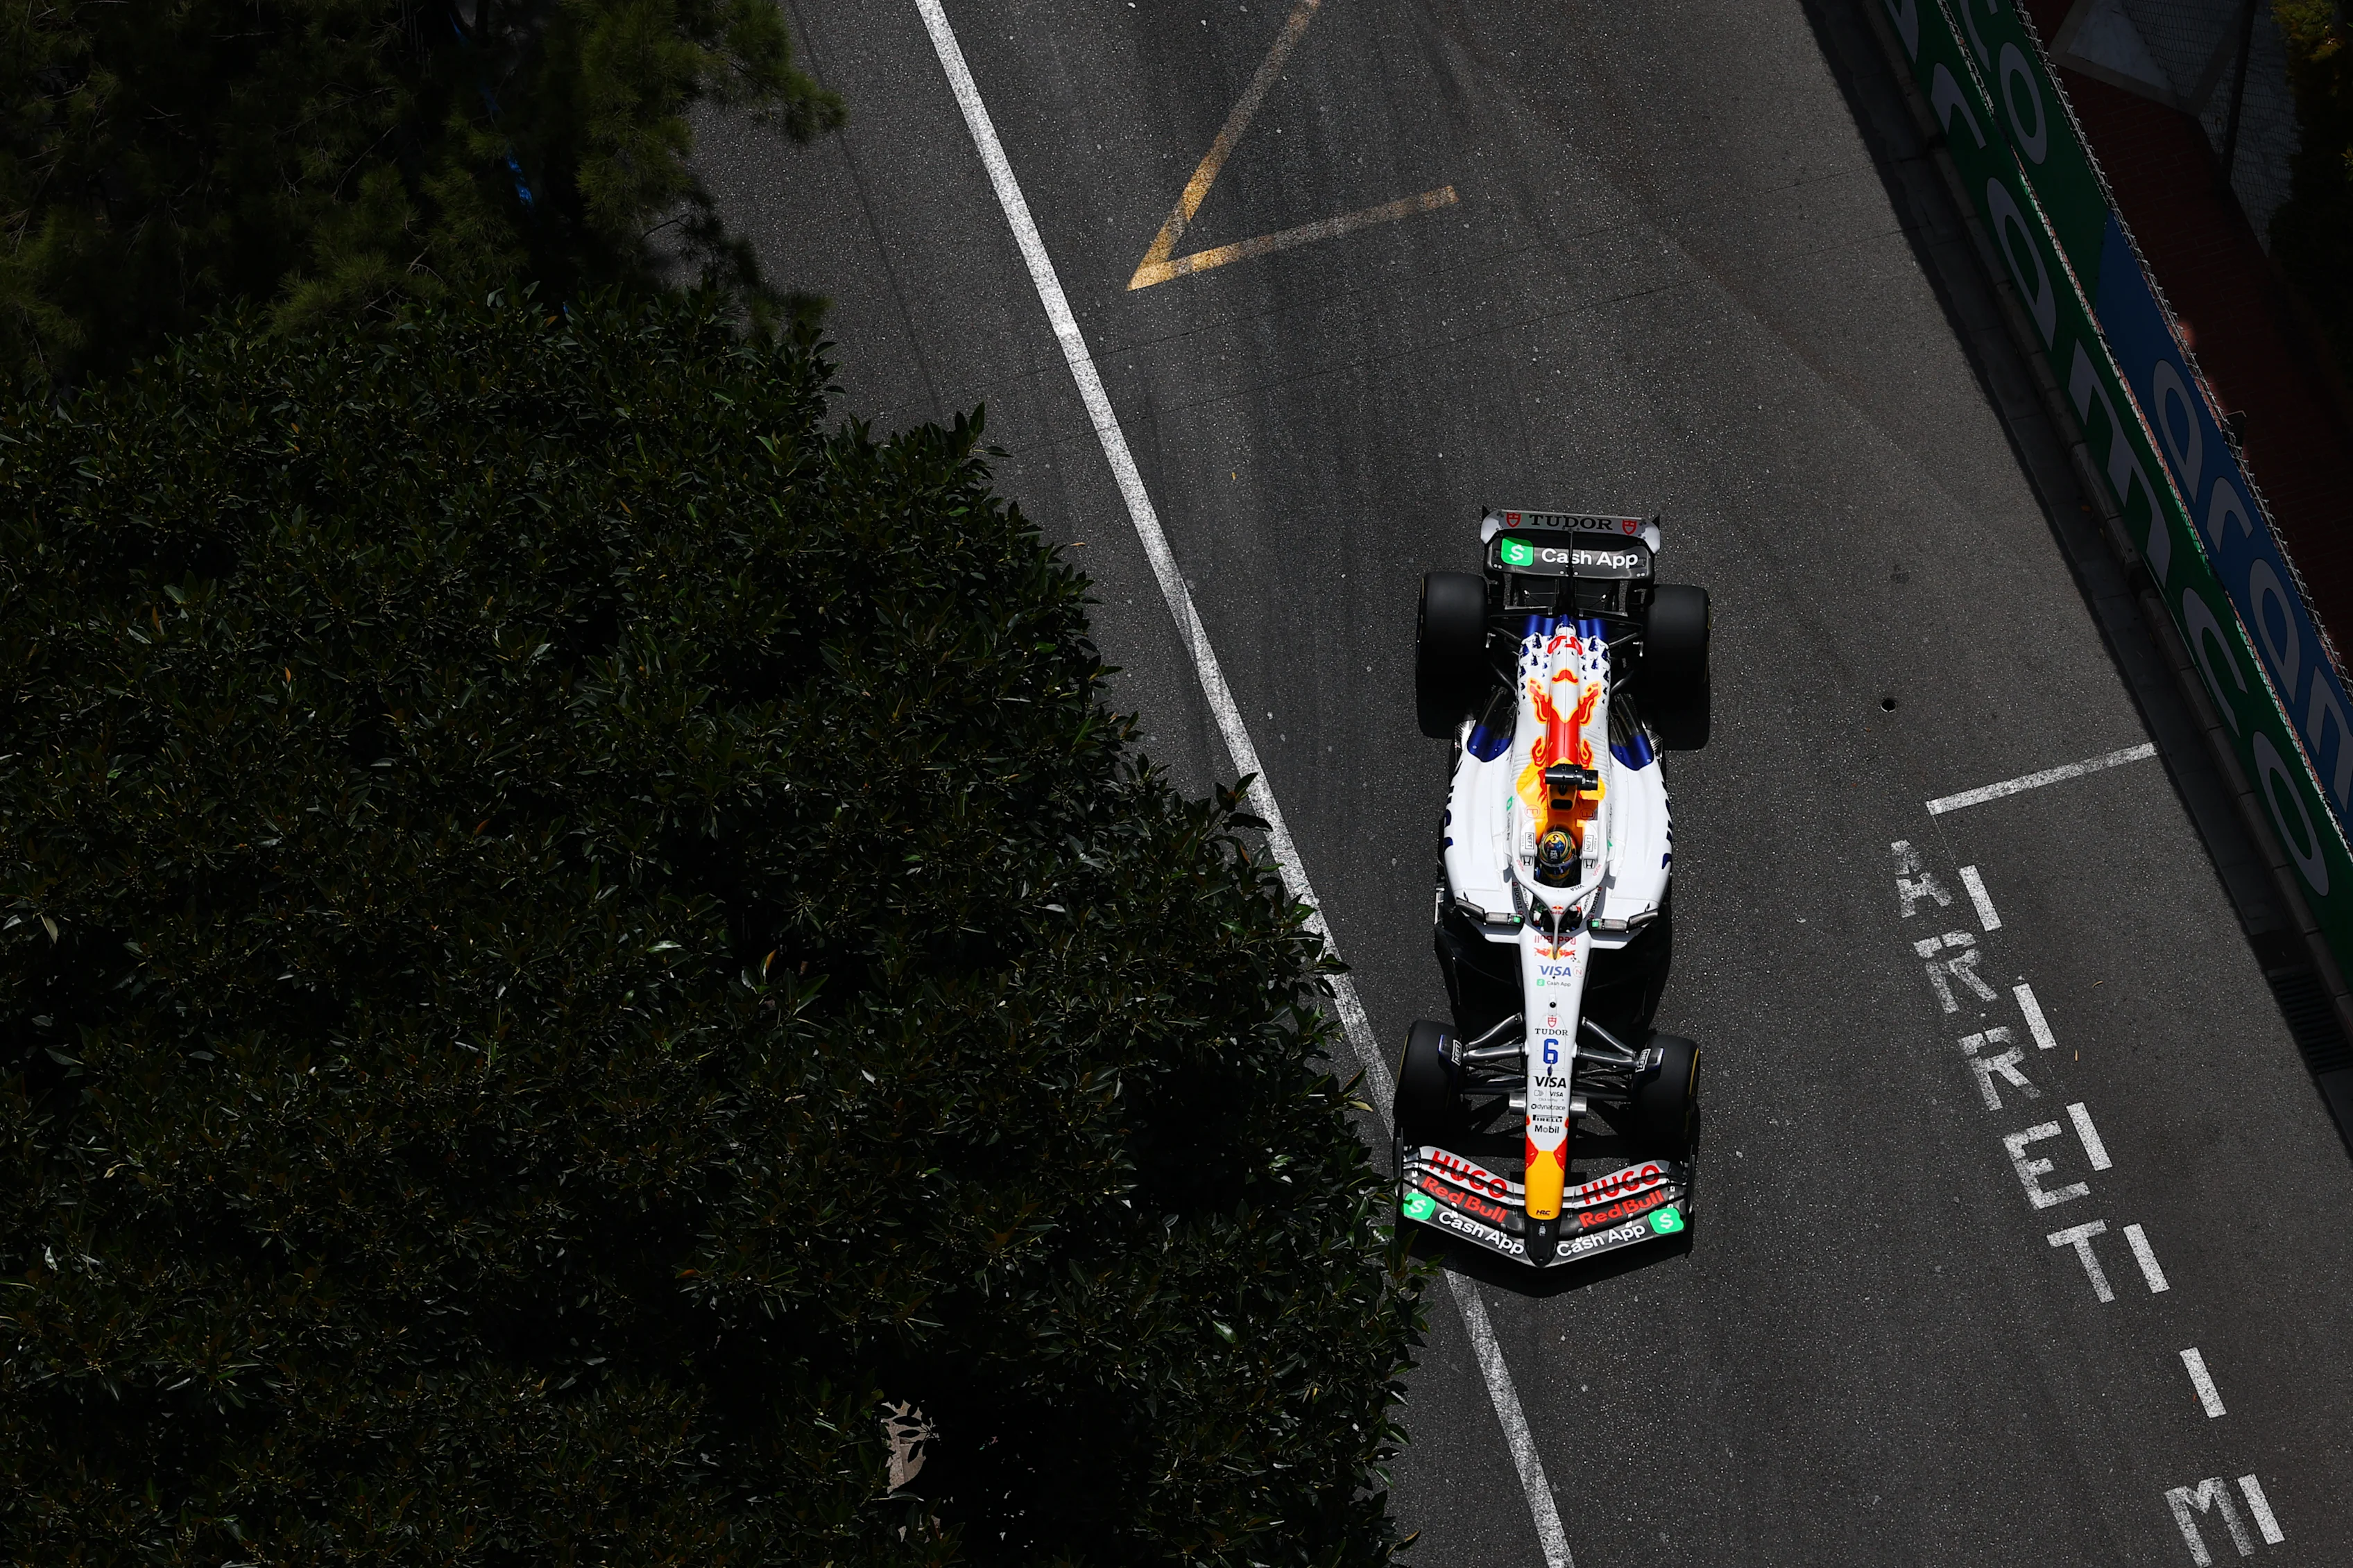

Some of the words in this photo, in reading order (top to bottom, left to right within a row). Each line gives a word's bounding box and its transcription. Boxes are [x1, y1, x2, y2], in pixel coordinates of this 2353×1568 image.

[1529, 515, 1613, 531] TUDOR
[1541, 548, 1592, 565] Cash
[1596, 552, 1638, 569] App
[1516, 859, 1525, 872] HUGO
[1593, 864, 1602, 876] HUGO
[1514, 888, 1523, 909] TUDOR
[1591, 891, 1601, 914] TUDOR
[1534, 935, 1554, 944] Bull
[1558, 936, 1576, 945] Red
[1538, 965, 1571, 976] VISA
[1543, 1038, 1559, 1065] 6
[1533, 1076, 1566, 1088] VISA
[1534, 1125, 1559, 1133] Mobil
[1429, 1150, 1507, 1198] HUGO
[1581, 1164, 1660, 1205] HUGO
[1421, 1175, 1466, 1205] Red
[1464, 1195, 1509, 1223] Bull
[1578, 1203, 1623, 1228] Red
[1622, 1189, 1665, 1214] Bull
[1438, 1211, 1484, 1238] Cash
[1485, 1230, 1525, 1255] App
[1557, 1234, 1605, 1257] Cash
[1608, 1224, 1646, 1243] App
